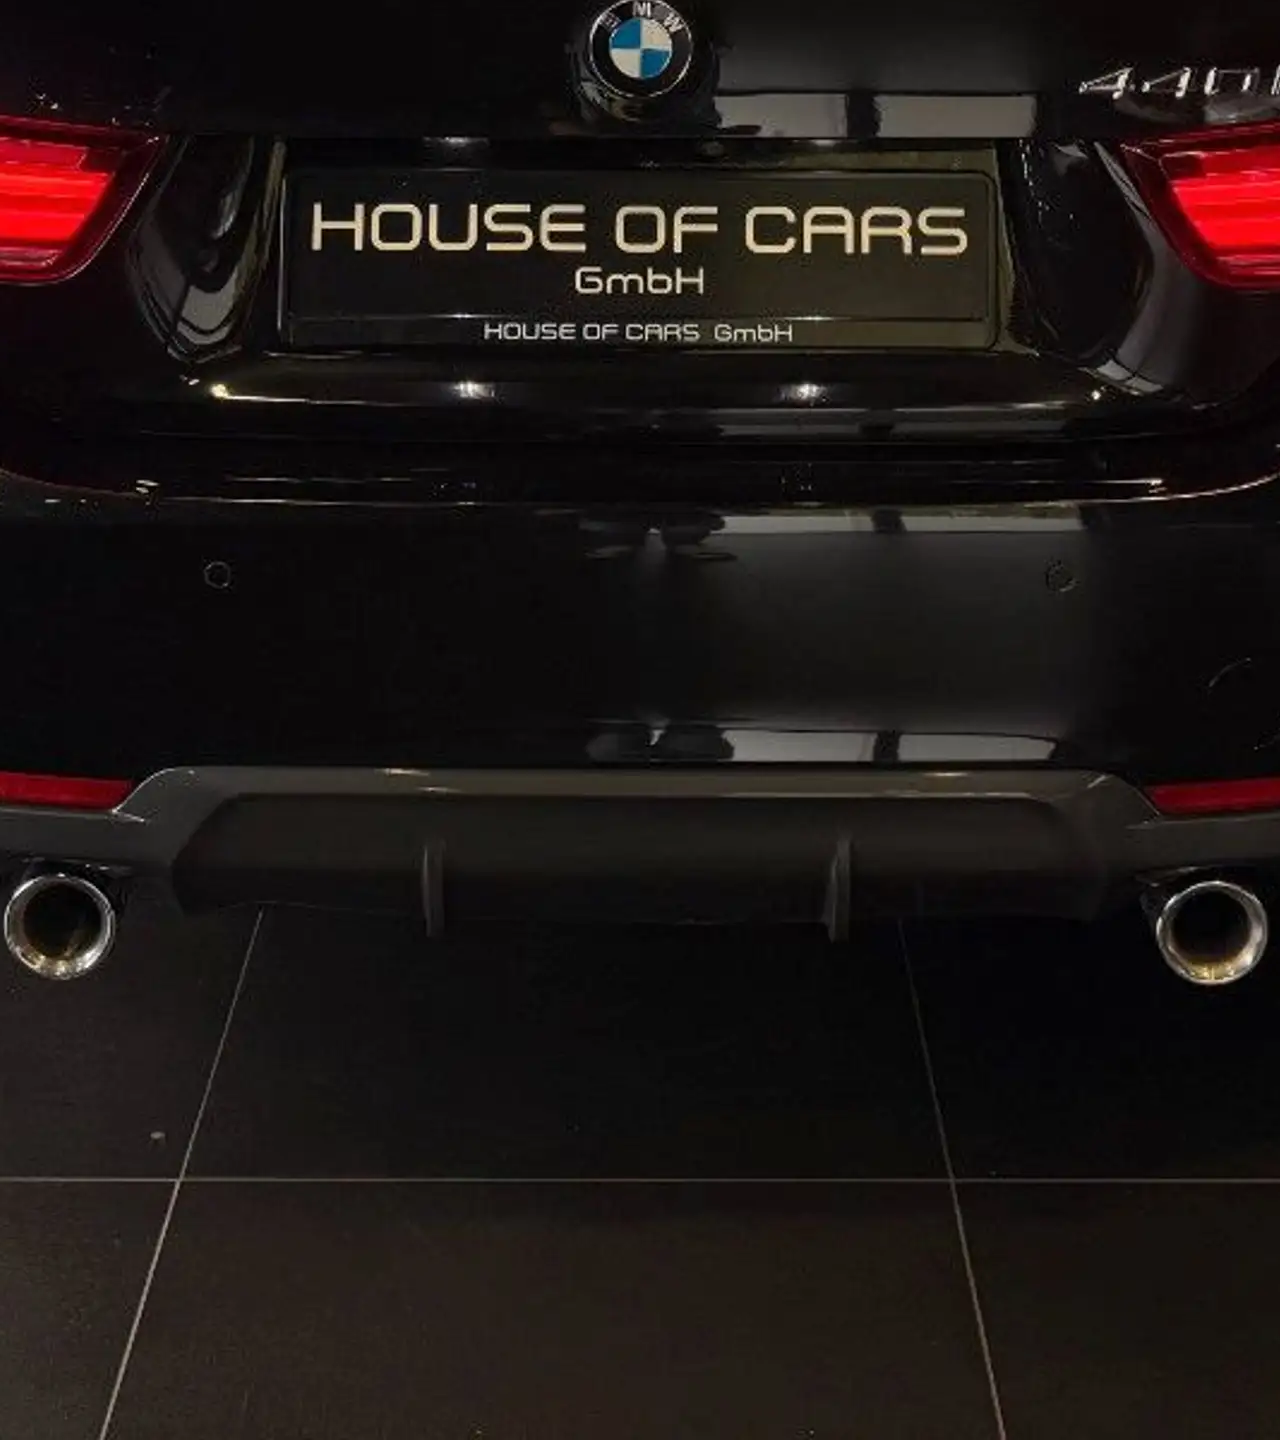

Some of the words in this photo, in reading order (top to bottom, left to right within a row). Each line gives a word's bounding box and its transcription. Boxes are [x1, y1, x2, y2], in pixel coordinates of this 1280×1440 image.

[311, 202, 587, 253] HOUSE
[614, 205, 719, 254] OF
[745, 205, 968, 256] CARS
[574, 266, 705, 295] GmbH
[483, 322, 577, 341] HOUSE
[582, 323, 619, 341] OF
[625, 323, 701, 342] CARS
[713, 323, 793, 343] GmbH
